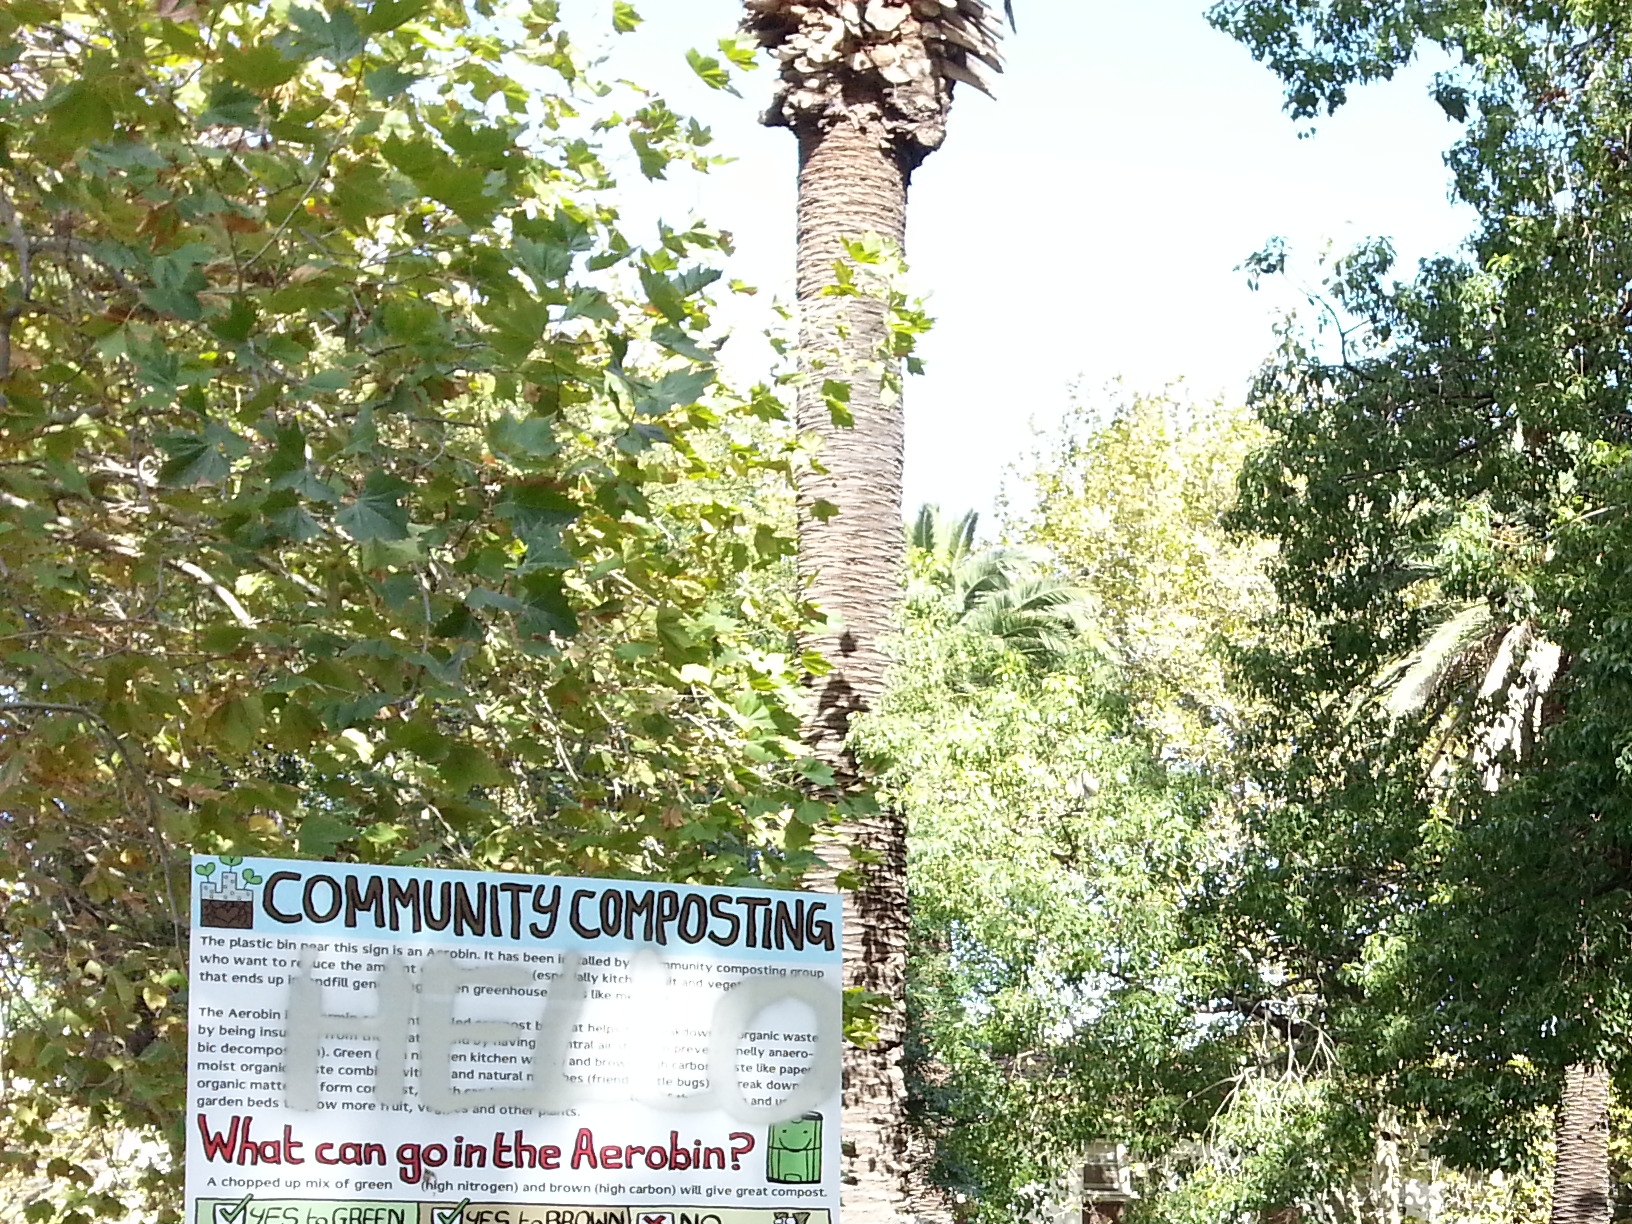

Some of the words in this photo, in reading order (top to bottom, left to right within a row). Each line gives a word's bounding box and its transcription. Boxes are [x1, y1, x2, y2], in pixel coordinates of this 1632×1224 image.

[262, 871, 561, 940] COMMUNITY
[569, 889, 835, 951] COMPOSTING
[198, 1113, 305, 1166] What
[315, 1142, 387, 1166] can
[396, 1142, 448, 1184] go
[454, 1136, 487, 1168] in
[492, 1130, 560, 1169] the
[570, 1127, 756, 1171] Aerobin?
[207, 1177, 216, 1187] A
[222, 1176, 280, 1189] chopped
[285, 1180, 300, 1191] up
[306, 1178, 329, 1188] mix
[335, 1179, 349, 1189] of
[355, 1181, 392, 1192] green
[420, 1182, 453, 1194] (high
[458, 1180, 518, 1194] nitrogen)
[523, 1182, 545, 1192] and
[550, 1182, 590, 1193] brown
[595, 1183, 625, 1195] (high
[629, 1184, 676, 1196] carbon)
[680, 1185, 701, 1195] will
[706, 1185, 731, 1198] give
[736, 1188, 767, 1198] great
[772, 1188, 827, 1199] compost.
